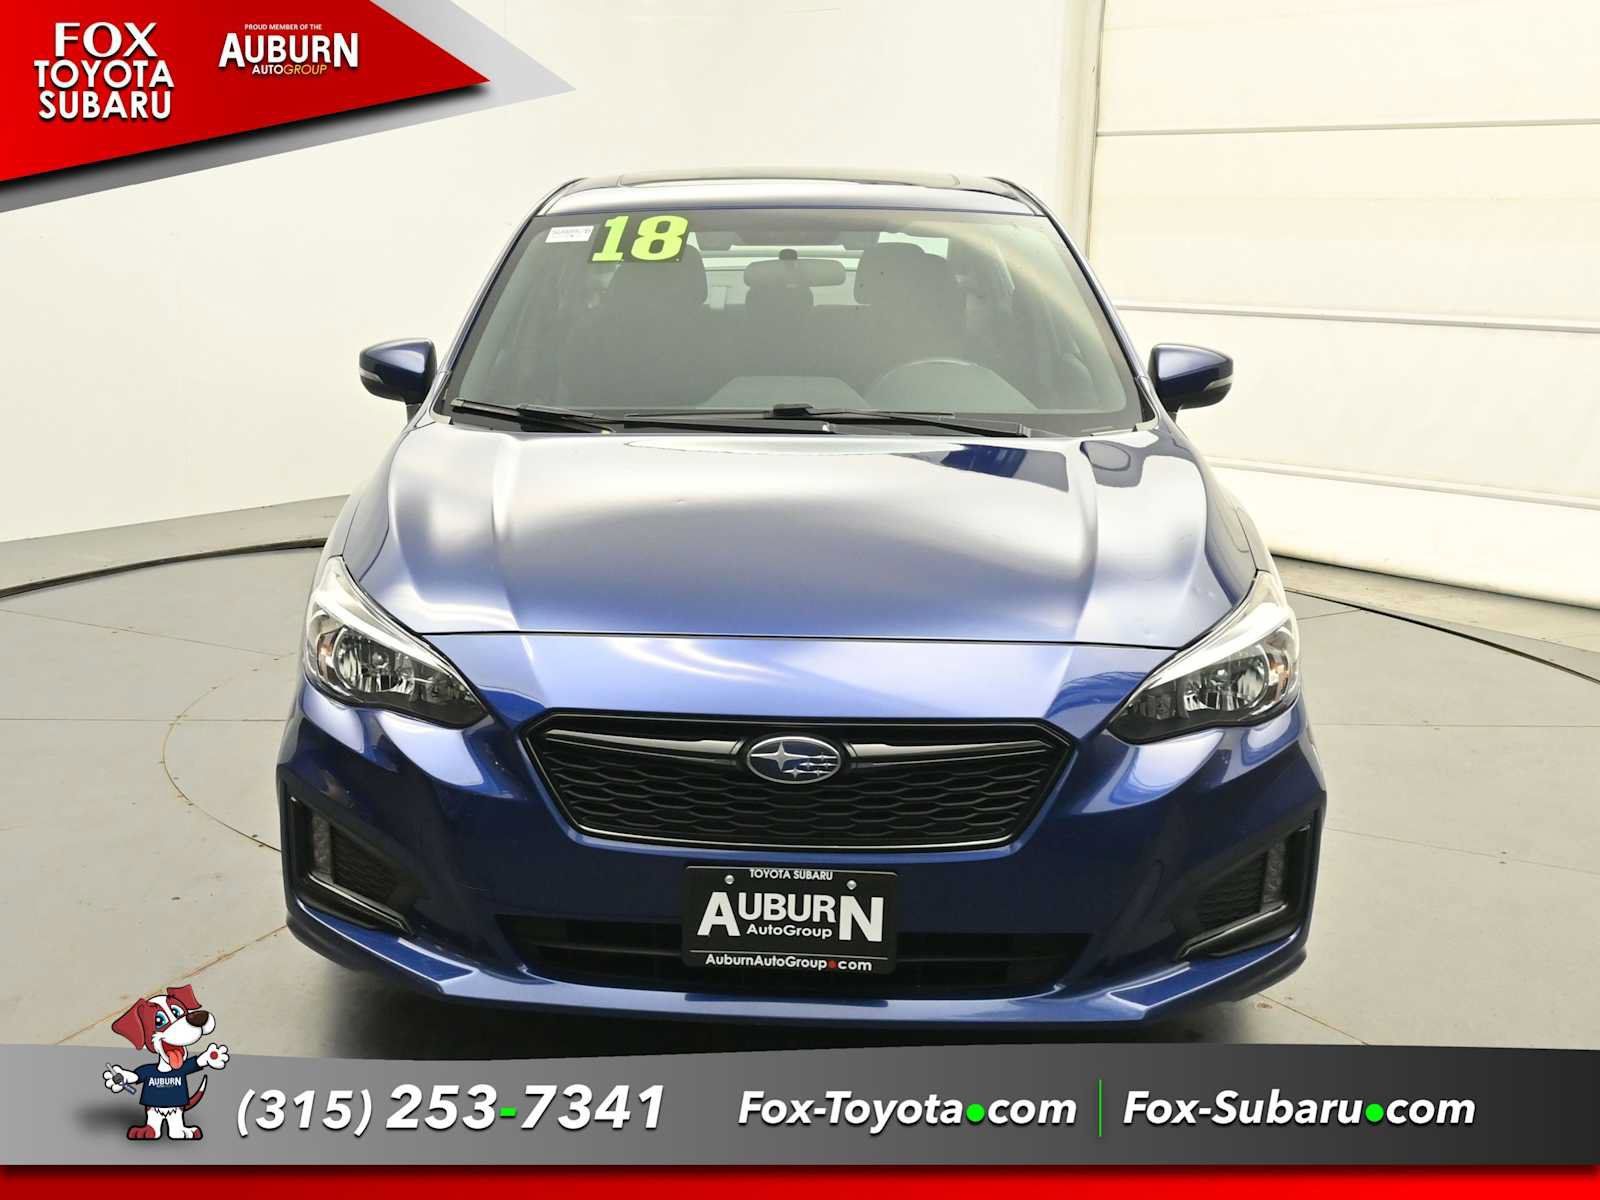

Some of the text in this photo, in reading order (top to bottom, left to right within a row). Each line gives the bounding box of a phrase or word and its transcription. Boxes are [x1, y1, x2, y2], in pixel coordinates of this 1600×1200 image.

[591, 215, 689, 262] 18
[749, 868, 834, 881] TOYOTA SUBARU
[696, 891, 885, 943] AUBURN
[746, 923, 833, 939] AutoGroup
